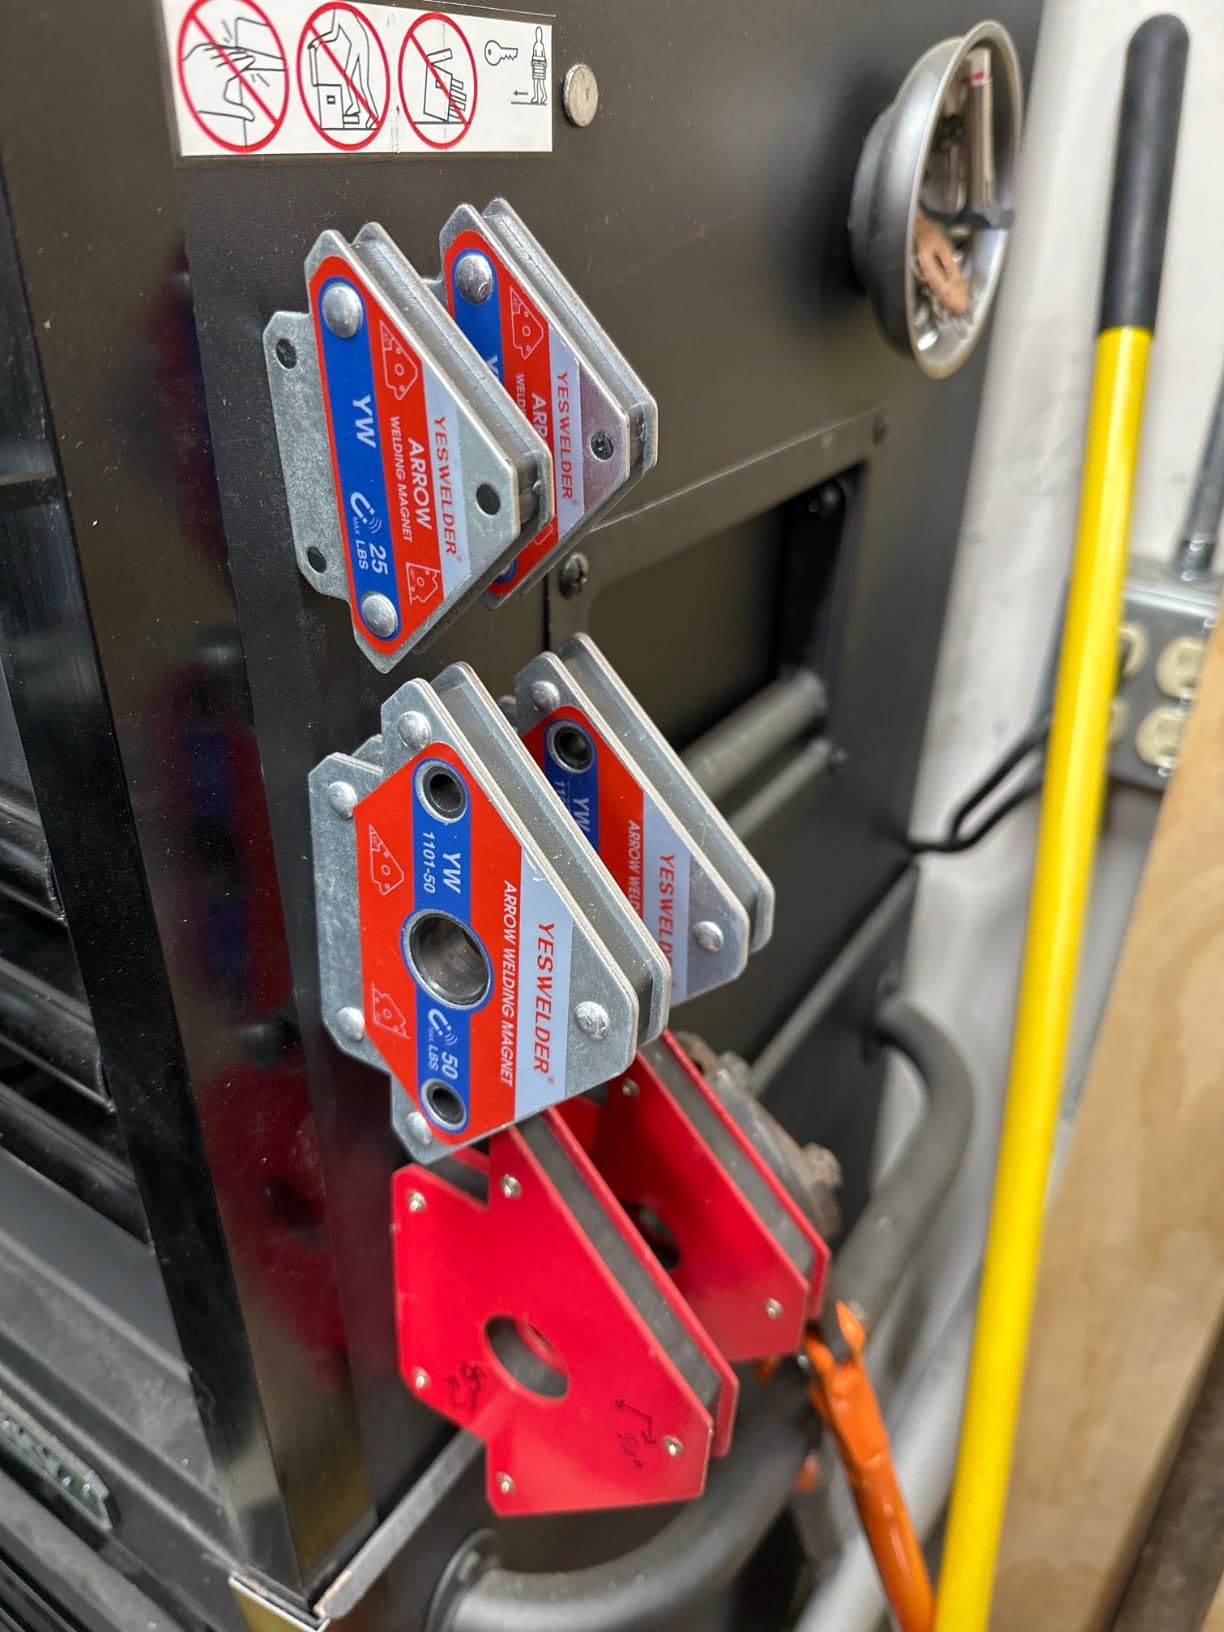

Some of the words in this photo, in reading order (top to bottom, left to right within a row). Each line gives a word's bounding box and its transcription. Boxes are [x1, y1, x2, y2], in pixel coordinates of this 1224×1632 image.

[352, 394, 377, 449] YW
[515, 373, 528, 415] WELD
[531, 391, 549, 439] ARR
[390, 416, 406, 480] WELDING
[556, 371, 574, 500] YESWELDER
[397, 483, 413, 543] MAGNET
[408, 437, 433, 530] ARROW
[434, 416, 458, 556] YESWELDER
[356, 539, 369, 571] LBS
[369, 543, 389, 576] 25
[422, 831, 437, 894] 1101-50
[442, 852, 462, 895] YW
[628, 819, 642, 874] ARROW
[503, 879, 518, 945] ARROW
[659, 853, 675, 967] YESWELD
[502, 948, 517, 1018] WELDING
[533, 922, 556, 1075] YESWELDER
[428, 1044, 440, 1072] LBS
[441, 1051, 459, 1080] 50
[500, 1020, 515, 1088] MAGNET
